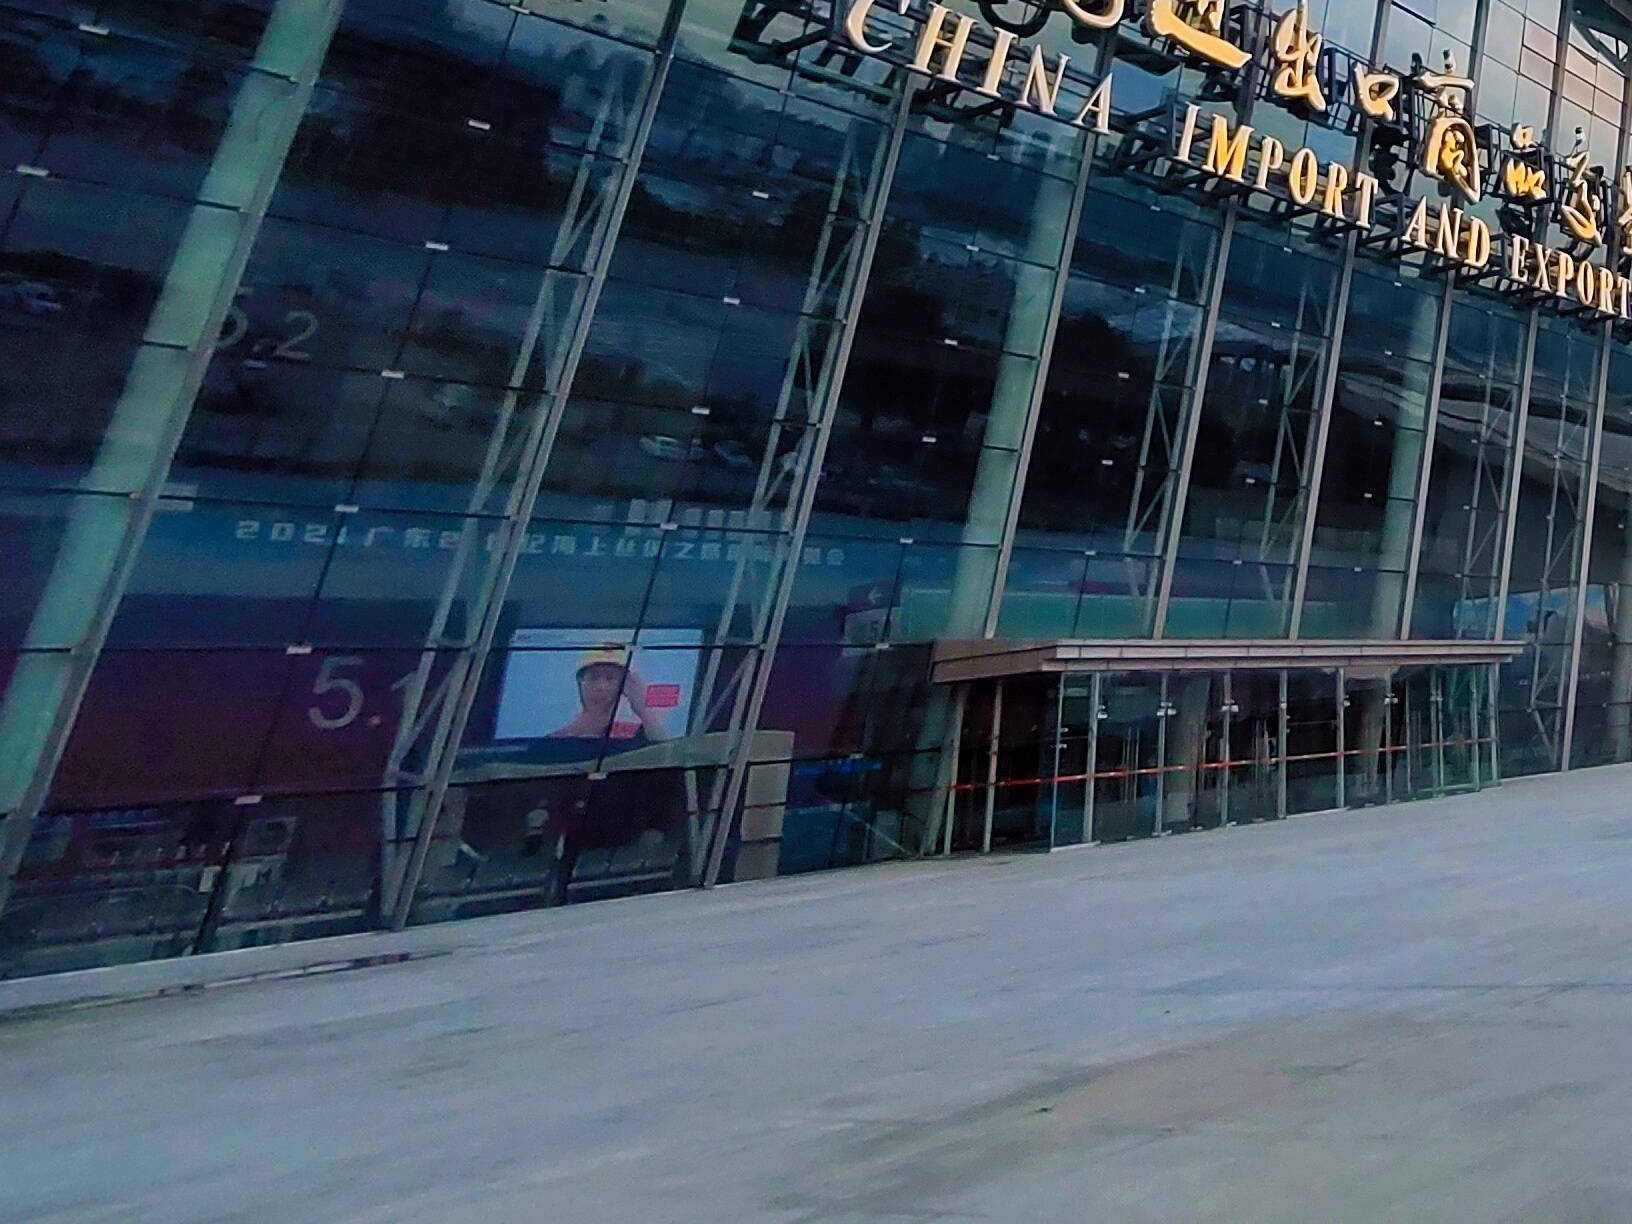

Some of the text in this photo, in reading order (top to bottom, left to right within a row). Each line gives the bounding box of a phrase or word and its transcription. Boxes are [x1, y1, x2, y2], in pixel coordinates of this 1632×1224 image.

[1174, 102, 1379, 230] IMPORT
[1401, 196, 1491, 269] AND
[1510, 234, 1632, 321] EXPORT
